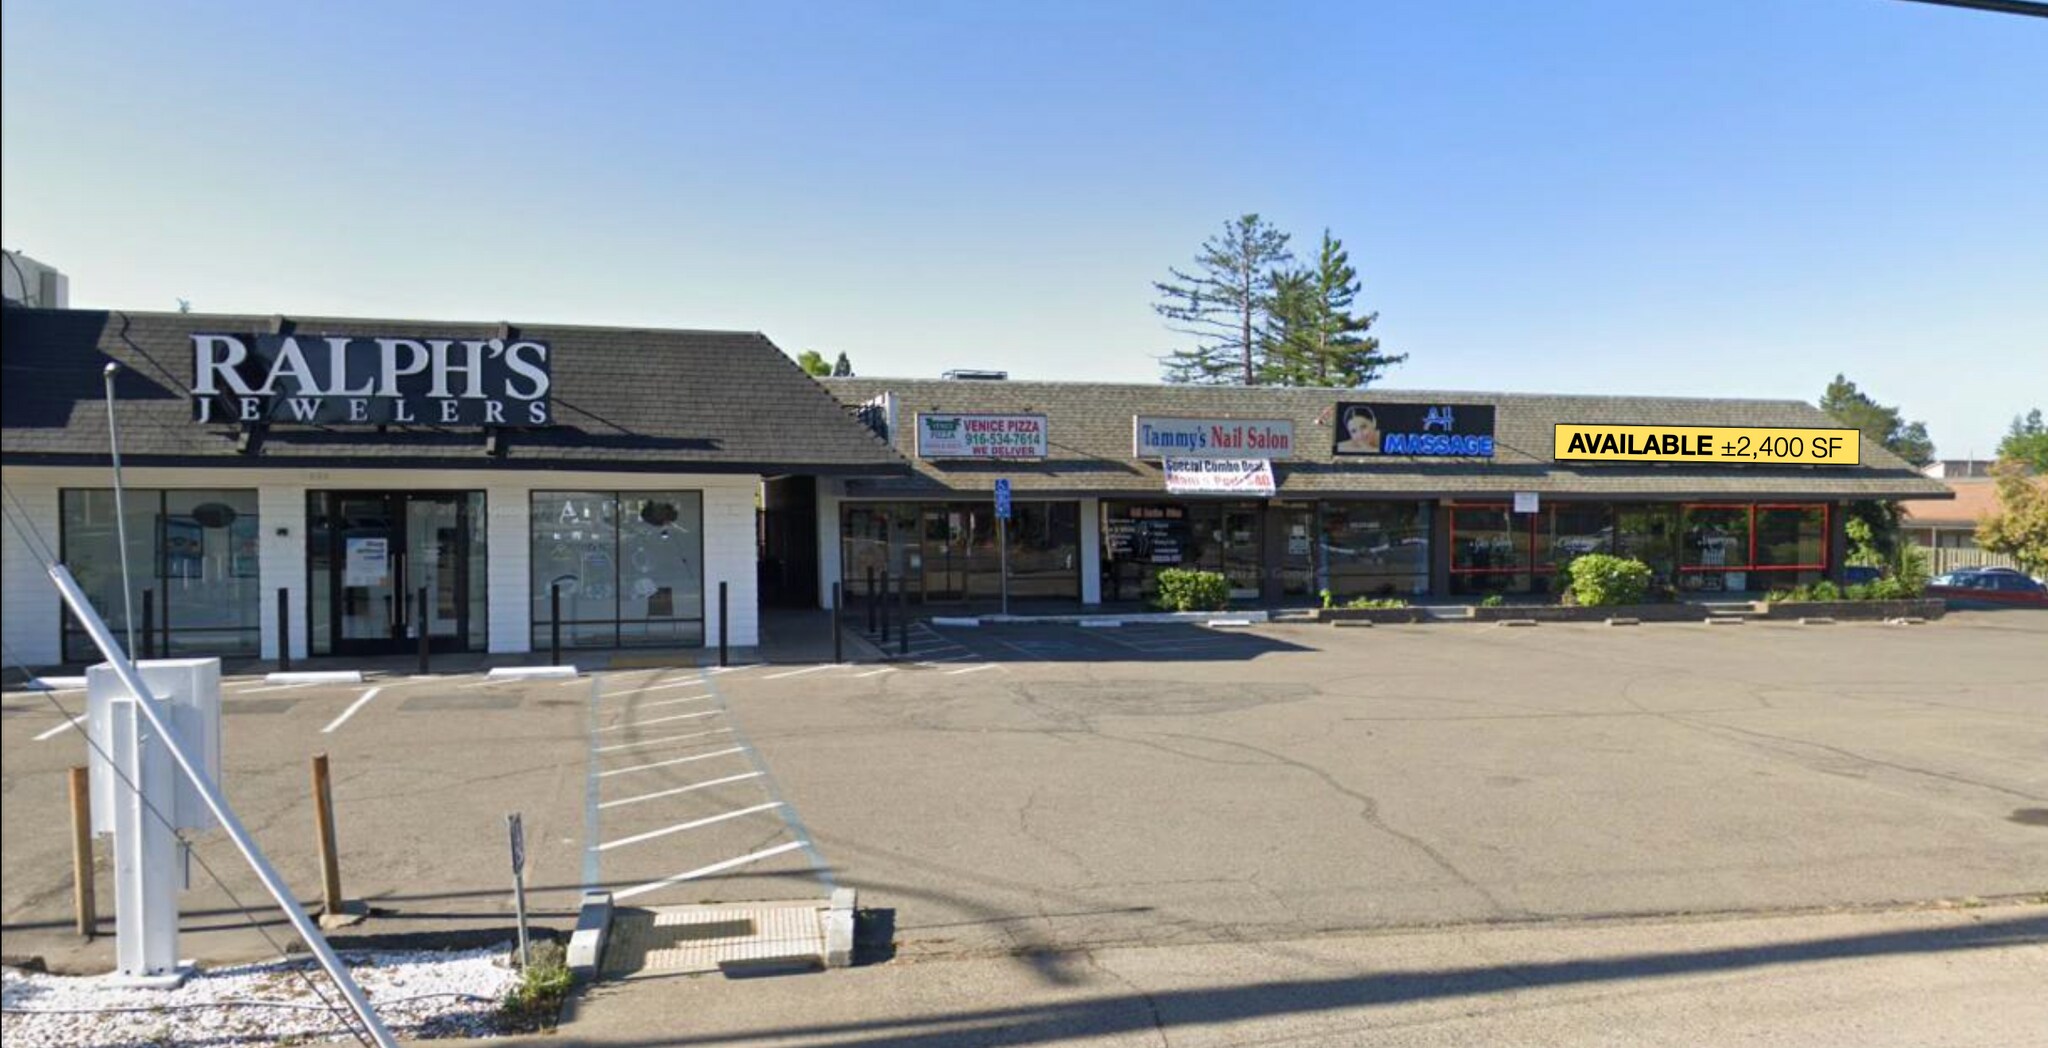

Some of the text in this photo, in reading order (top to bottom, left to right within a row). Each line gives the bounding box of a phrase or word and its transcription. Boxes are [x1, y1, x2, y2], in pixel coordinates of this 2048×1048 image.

[188, 334, 549, 400] RALPH'S
[198, 397, 546, 424] JEWELERS
[963, 420, 1040, 432] VENICE PIZZA
[965, 433, 1040, 445] 916-534-7614
[1142, 424, 1289, 452] Tammy's Nail Salon
[1384, 433, 1493, 455] MASSAGE
[972, 446, 988, 455] WE
[991, 446, 1035, 456] DELIVER
[1204, 460, 1240, 473] Combo
